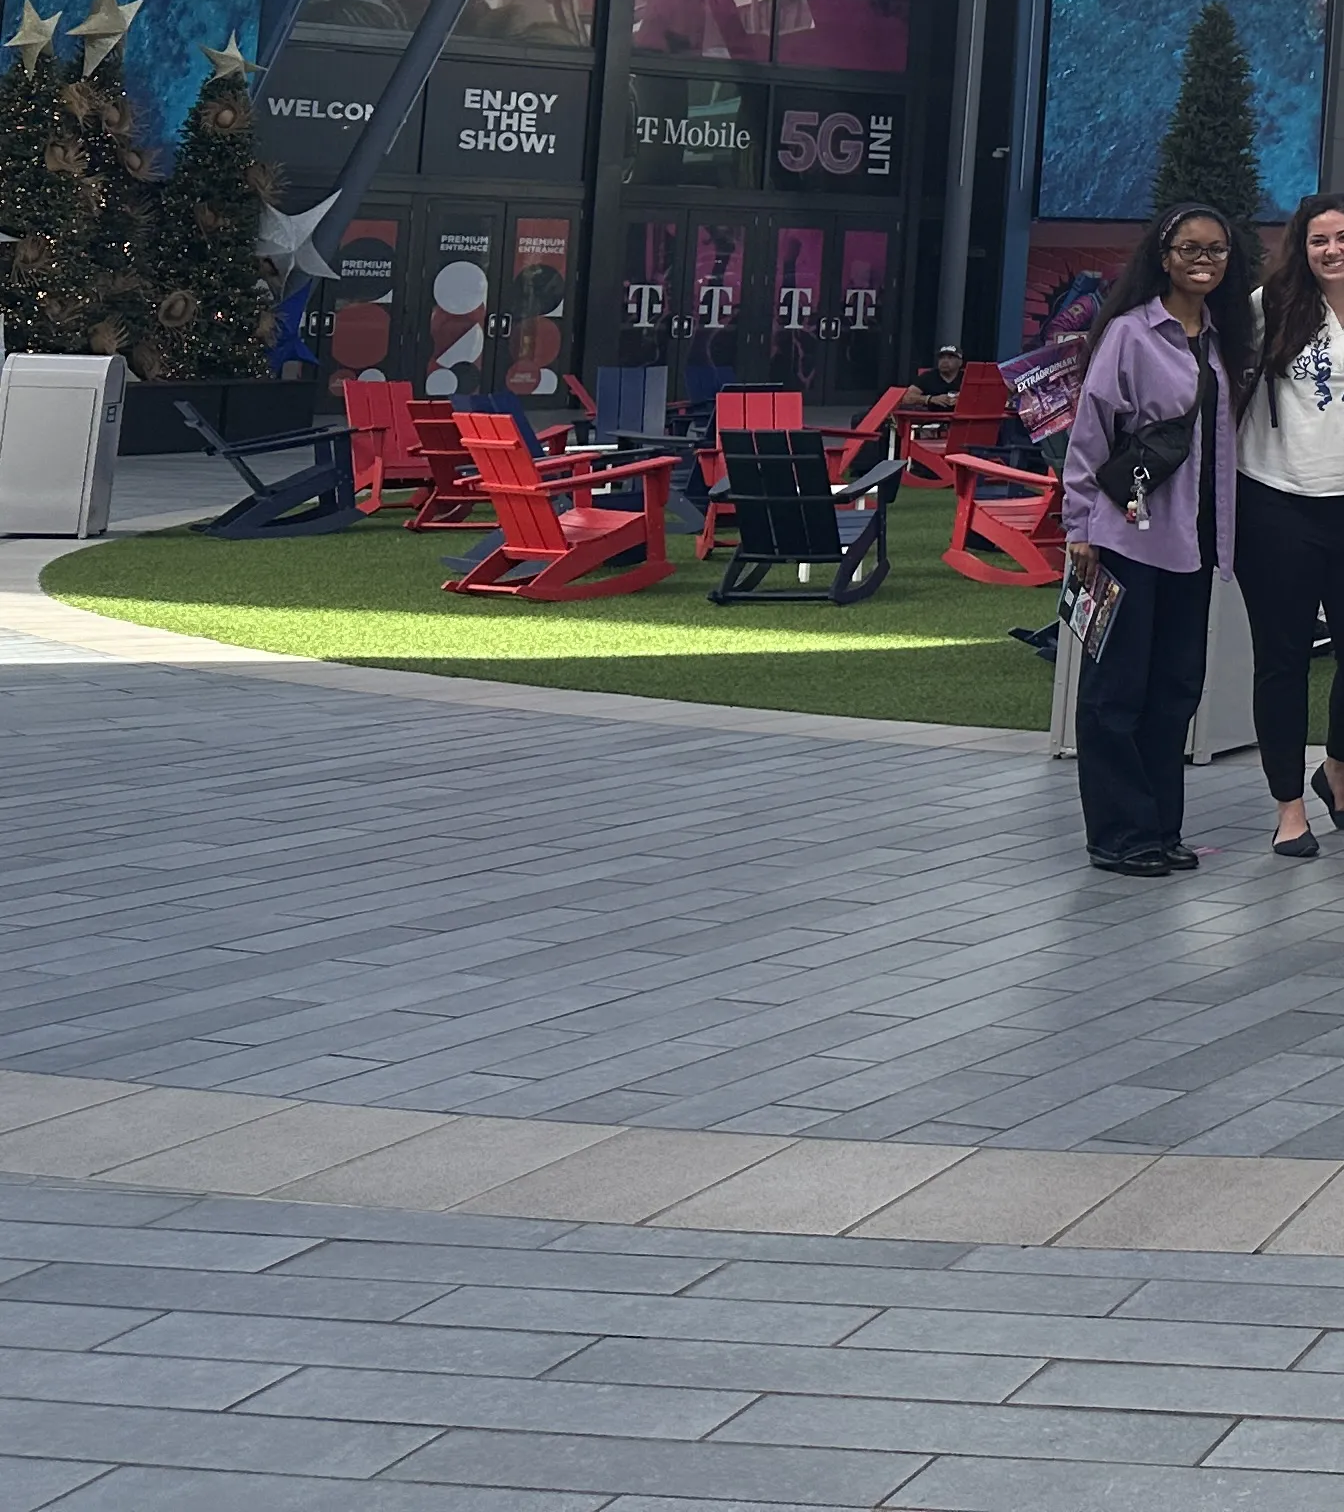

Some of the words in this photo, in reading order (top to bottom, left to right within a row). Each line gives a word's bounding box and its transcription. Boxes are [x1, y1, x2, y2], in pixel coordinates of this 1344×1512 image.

[268, 97, 374, 122] WELCO
[464, 88, 559, 114] ENJOY
[482, 110, 537, 133] THE
[458, 129, 557, 154] SHOW!
[778, 110, 864, 174] 5G
[867, 115, 893, 175] LINE
[440, 234, 489, 245] PREMIUM
[440, 243, 489, 253] ENTRANCE
[518, 246, 566, 256] ENTRANCE
[519, 237, 566, 248] PREMIUM
[341, 259, 392, 270] PREMIUM
[341, 268, 392, 278] ENTRANCE
[1017, 354, 1078, 393] EXTRAORDINARY
